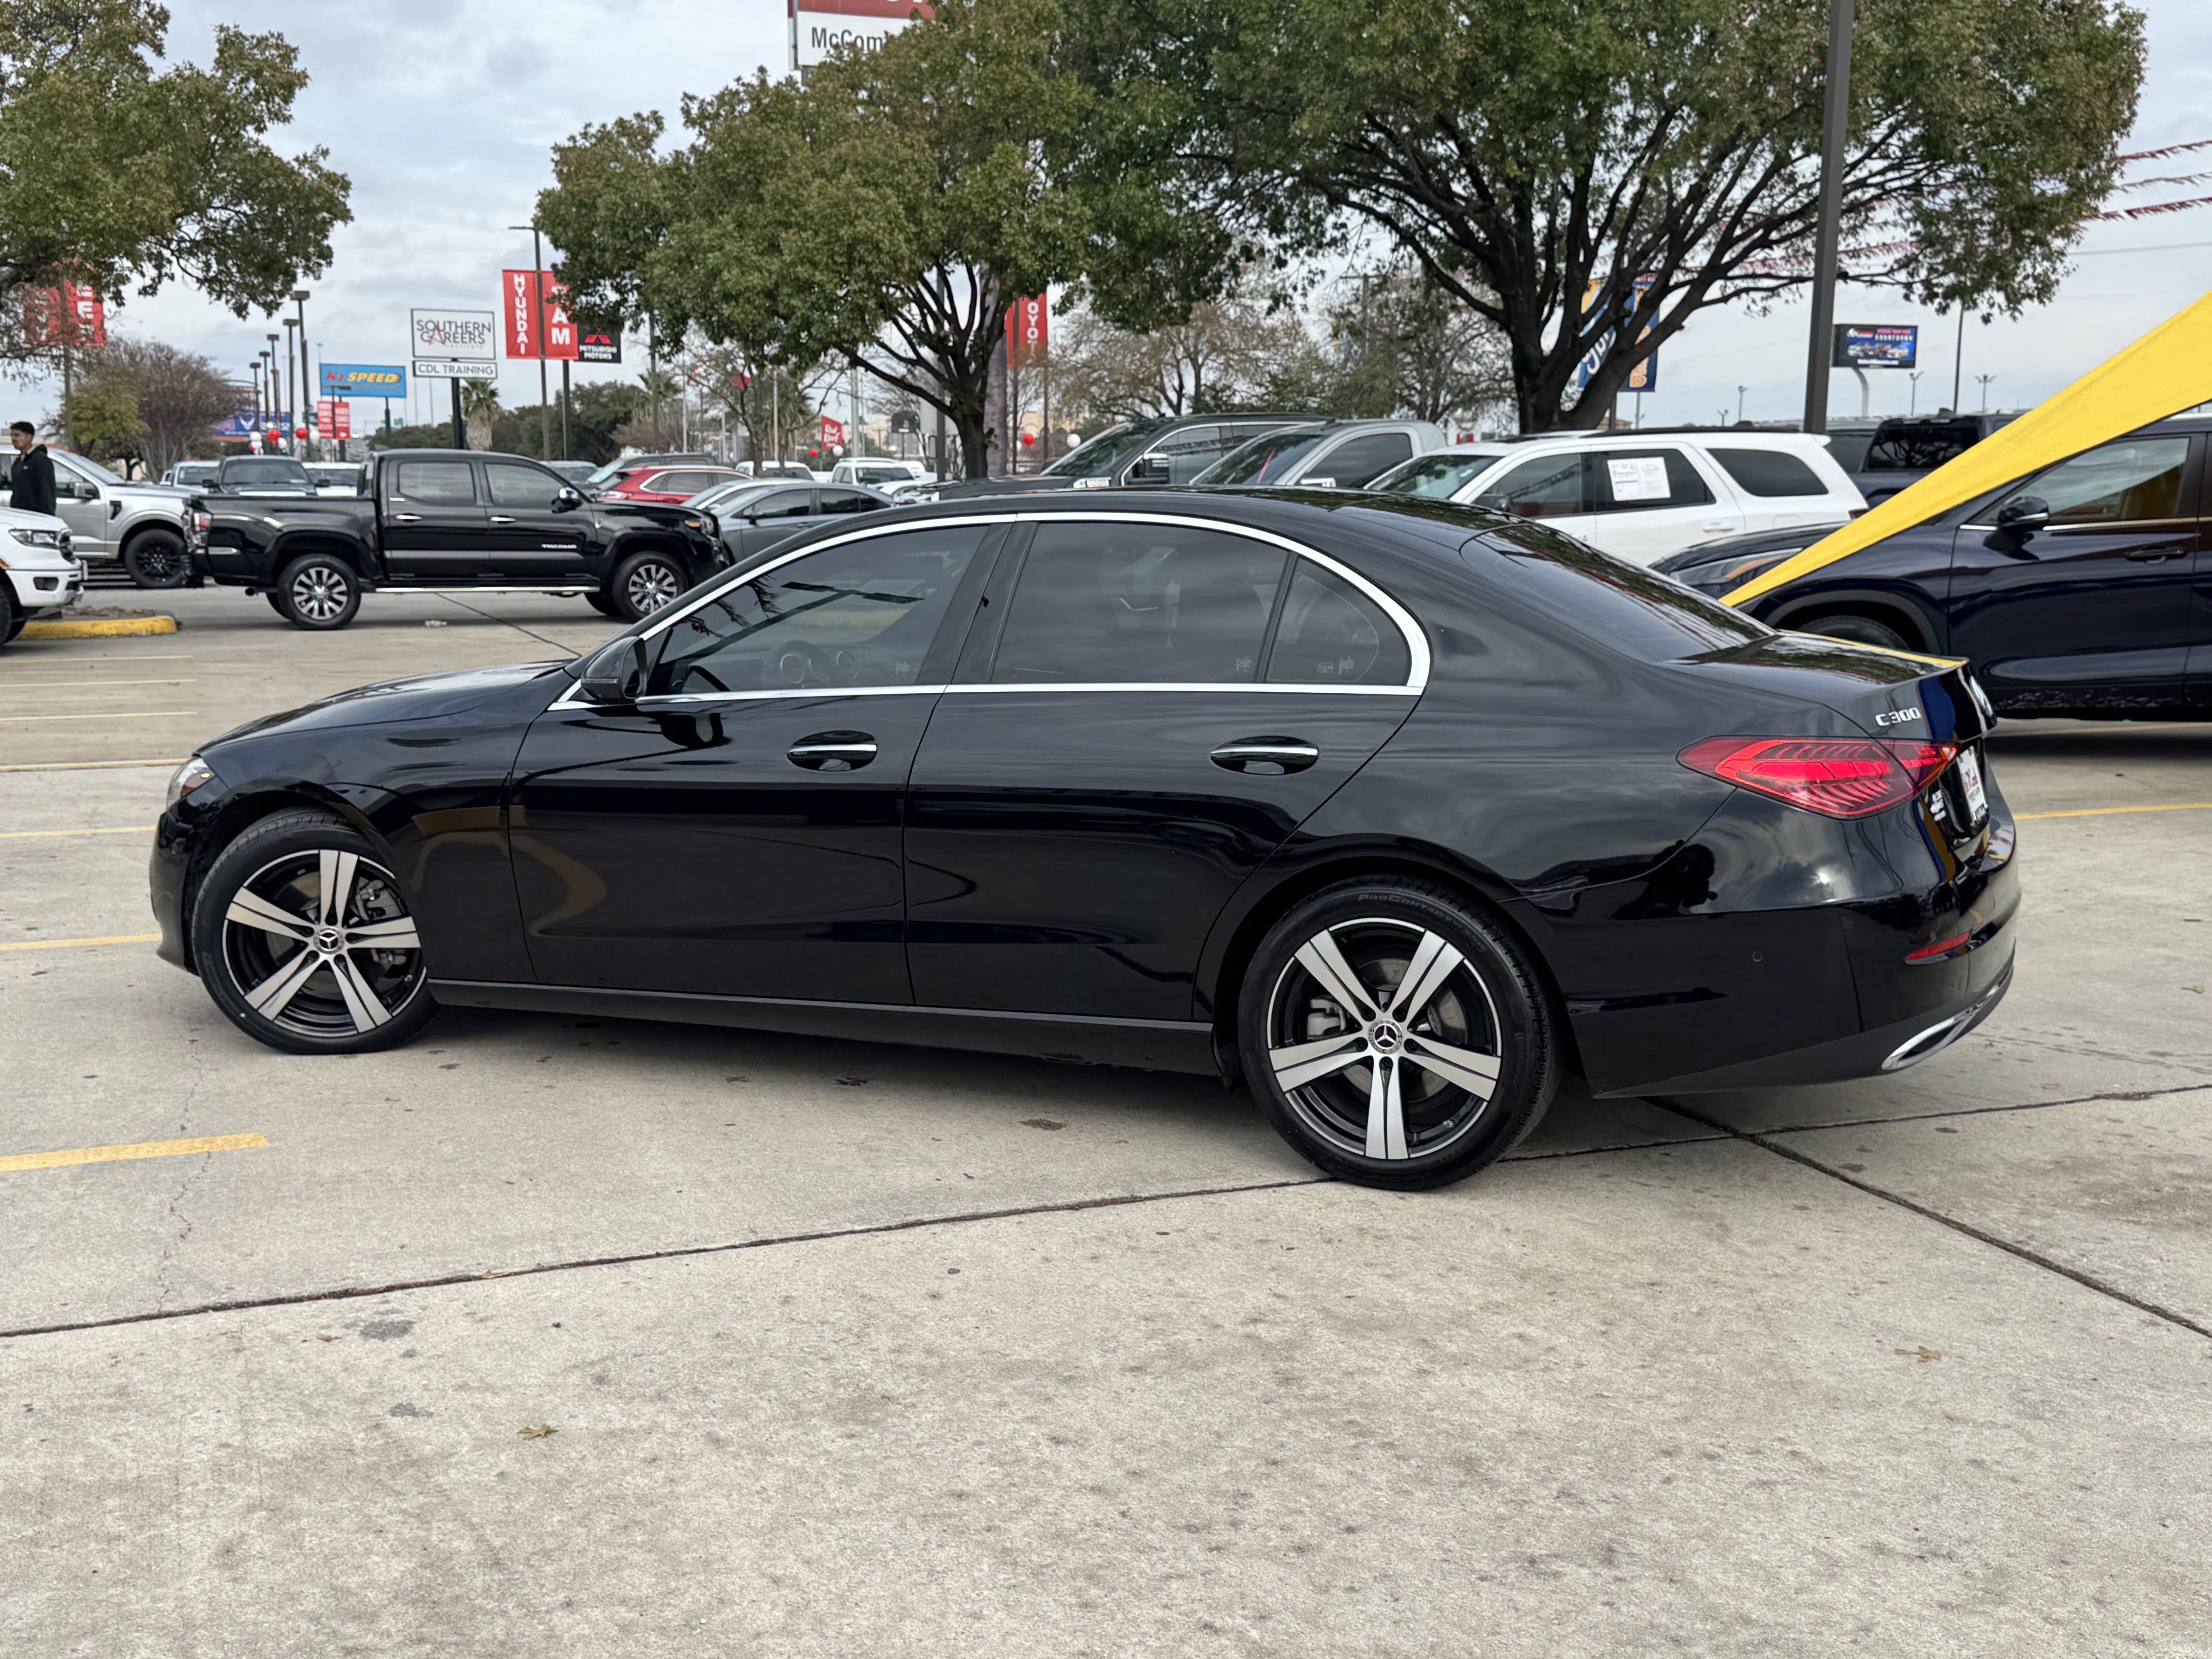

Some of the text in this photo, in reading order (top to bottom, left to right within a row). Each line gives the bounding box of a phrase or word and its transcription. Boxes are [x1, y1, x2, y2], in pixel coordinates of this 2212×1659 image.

[811, 26, 890, 53] McCom
[514, 274, 529, 355] HYUNDAI
[416, 319, 491, 335] SOUTHERN
[420, 325, 485, 345] CAREERS
[347, 372, 402, 383] SPEED
[418, 364, 494, 375] CDL TRAINING
